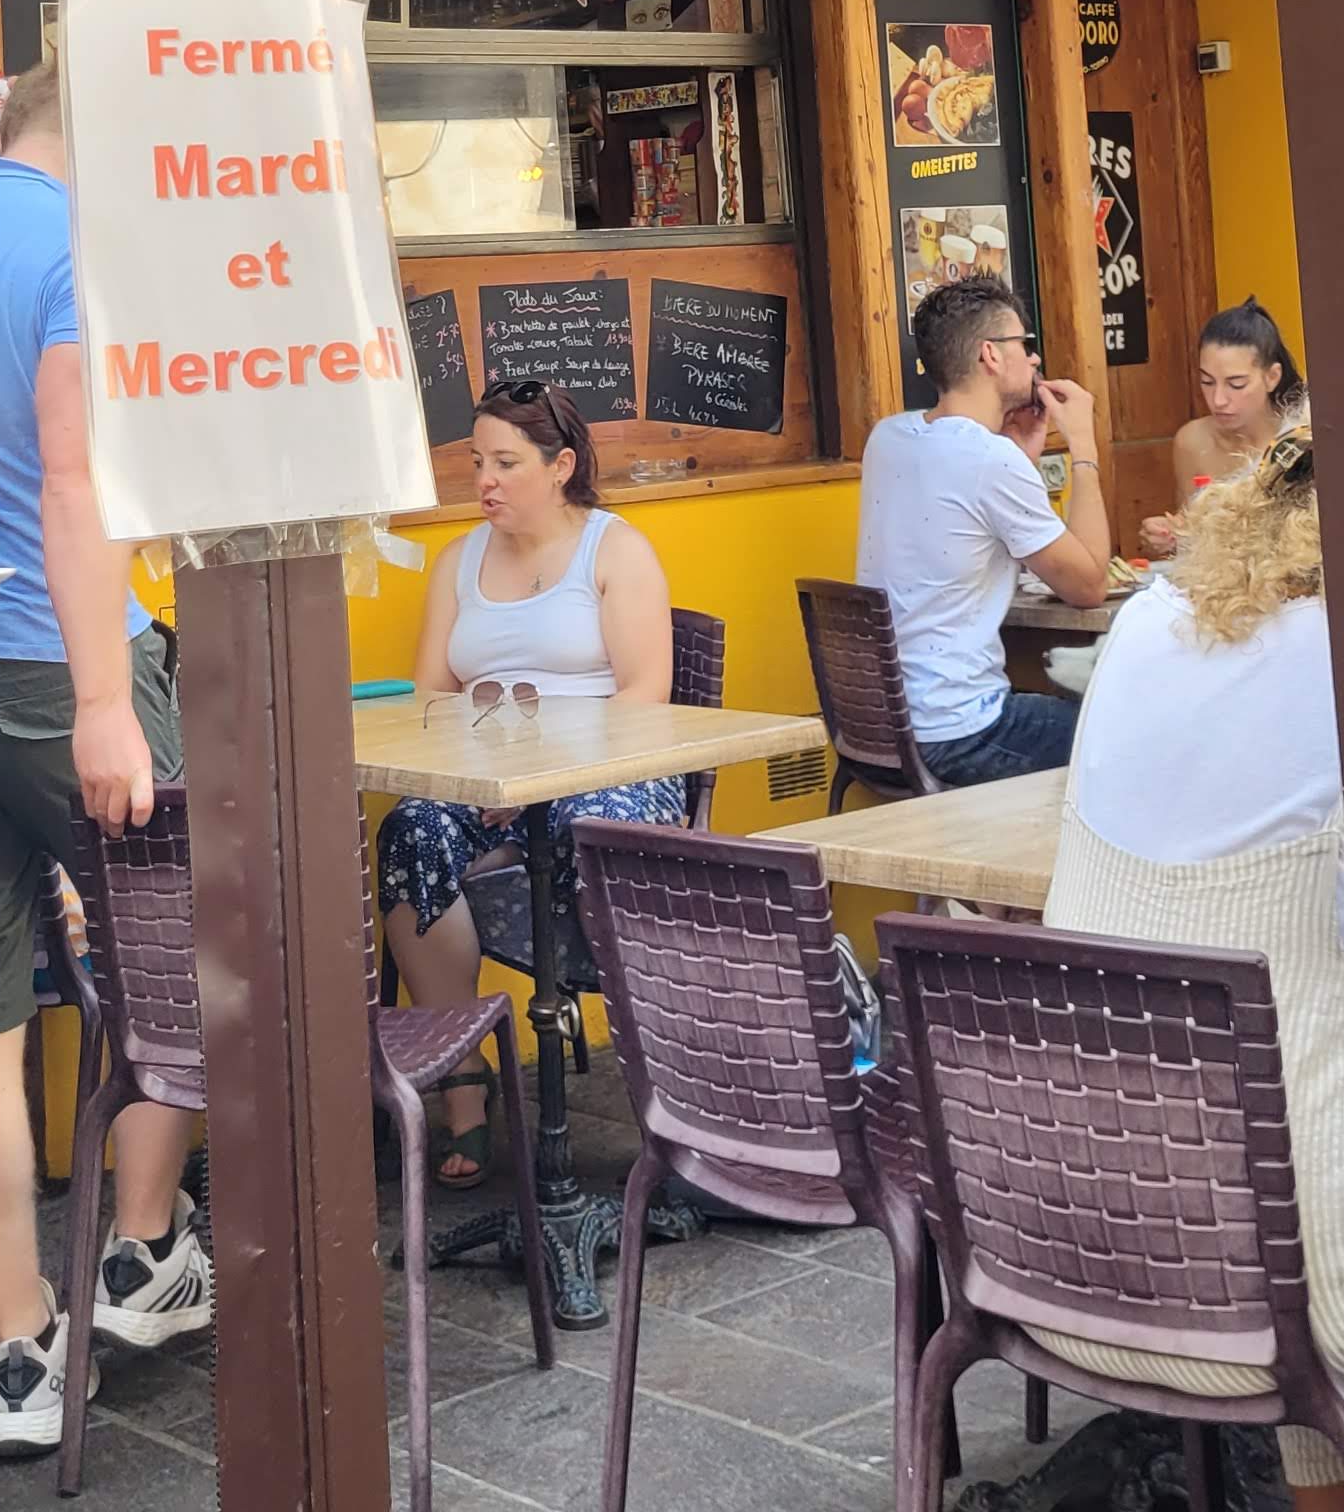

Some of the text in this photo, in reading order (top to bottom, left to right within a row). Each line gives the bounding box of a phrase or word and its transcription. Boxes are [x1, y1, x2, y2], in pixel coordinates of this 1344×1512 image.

[146, 27, 337, 77] Fermé
[152, 139, 346, 201] Mardi
[911, 151, 978, 179] OMELETTES
[226, 240, 291, 288] et
[540, 292, 558, 306] du
[105, 326, 404, 401] Mercredi
